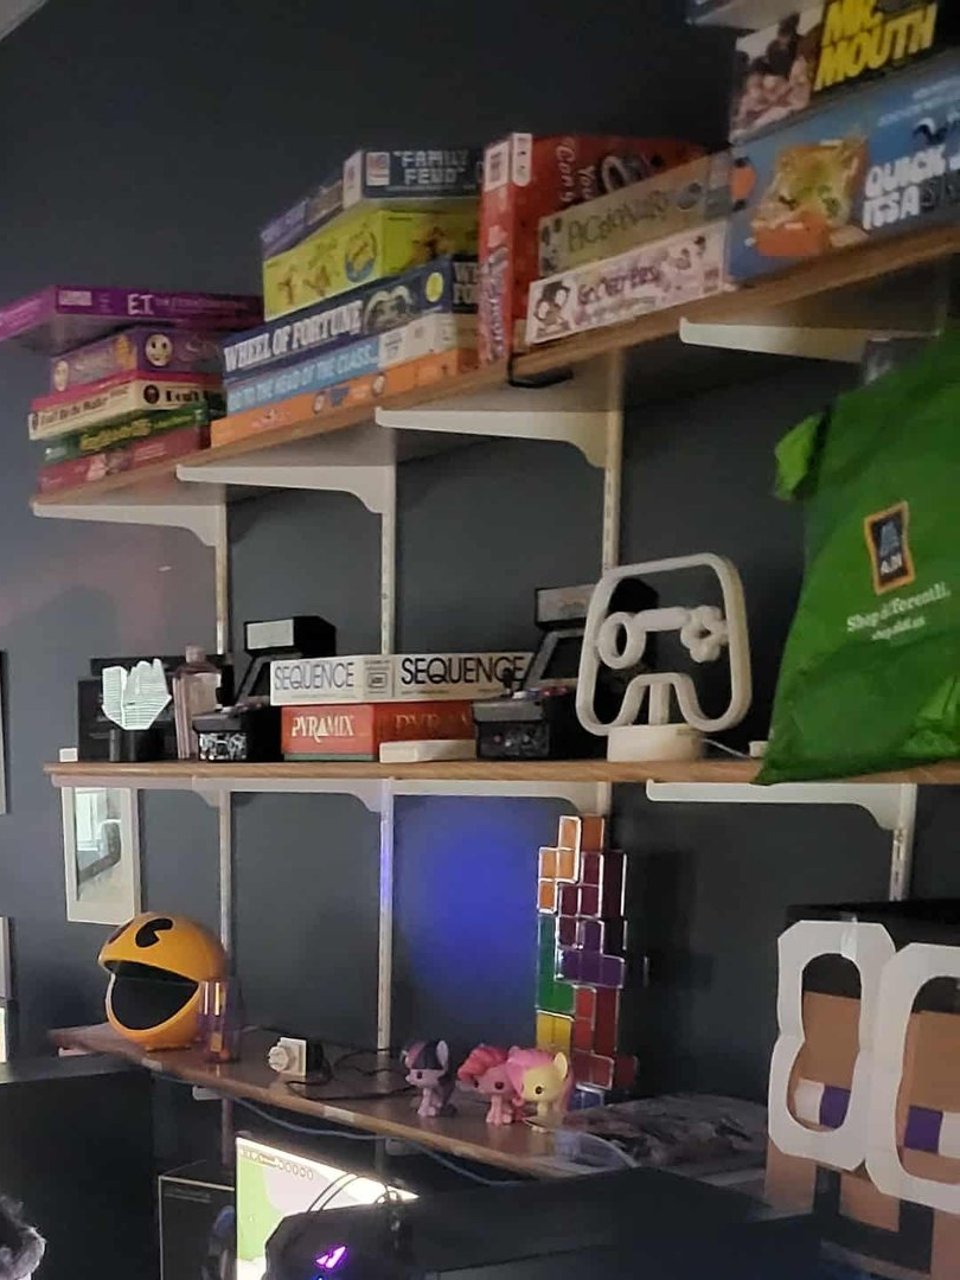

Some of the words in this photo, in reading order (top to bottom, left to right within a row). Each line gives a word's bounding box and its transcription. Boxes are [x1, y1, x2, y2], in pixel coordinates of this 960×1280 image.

[813, 3, 937, 91] MOUTH
[224, 334, 270, 372] WHEEL
[272, 325, 291, 355] OF
[292, 301, 362, 349] FORTUNE
[274, 661, 354, 691] SEQUENCE
[401, 656, 525, 685] SEQUENCE
[292, 715, 354, 743] PYRAMIX
